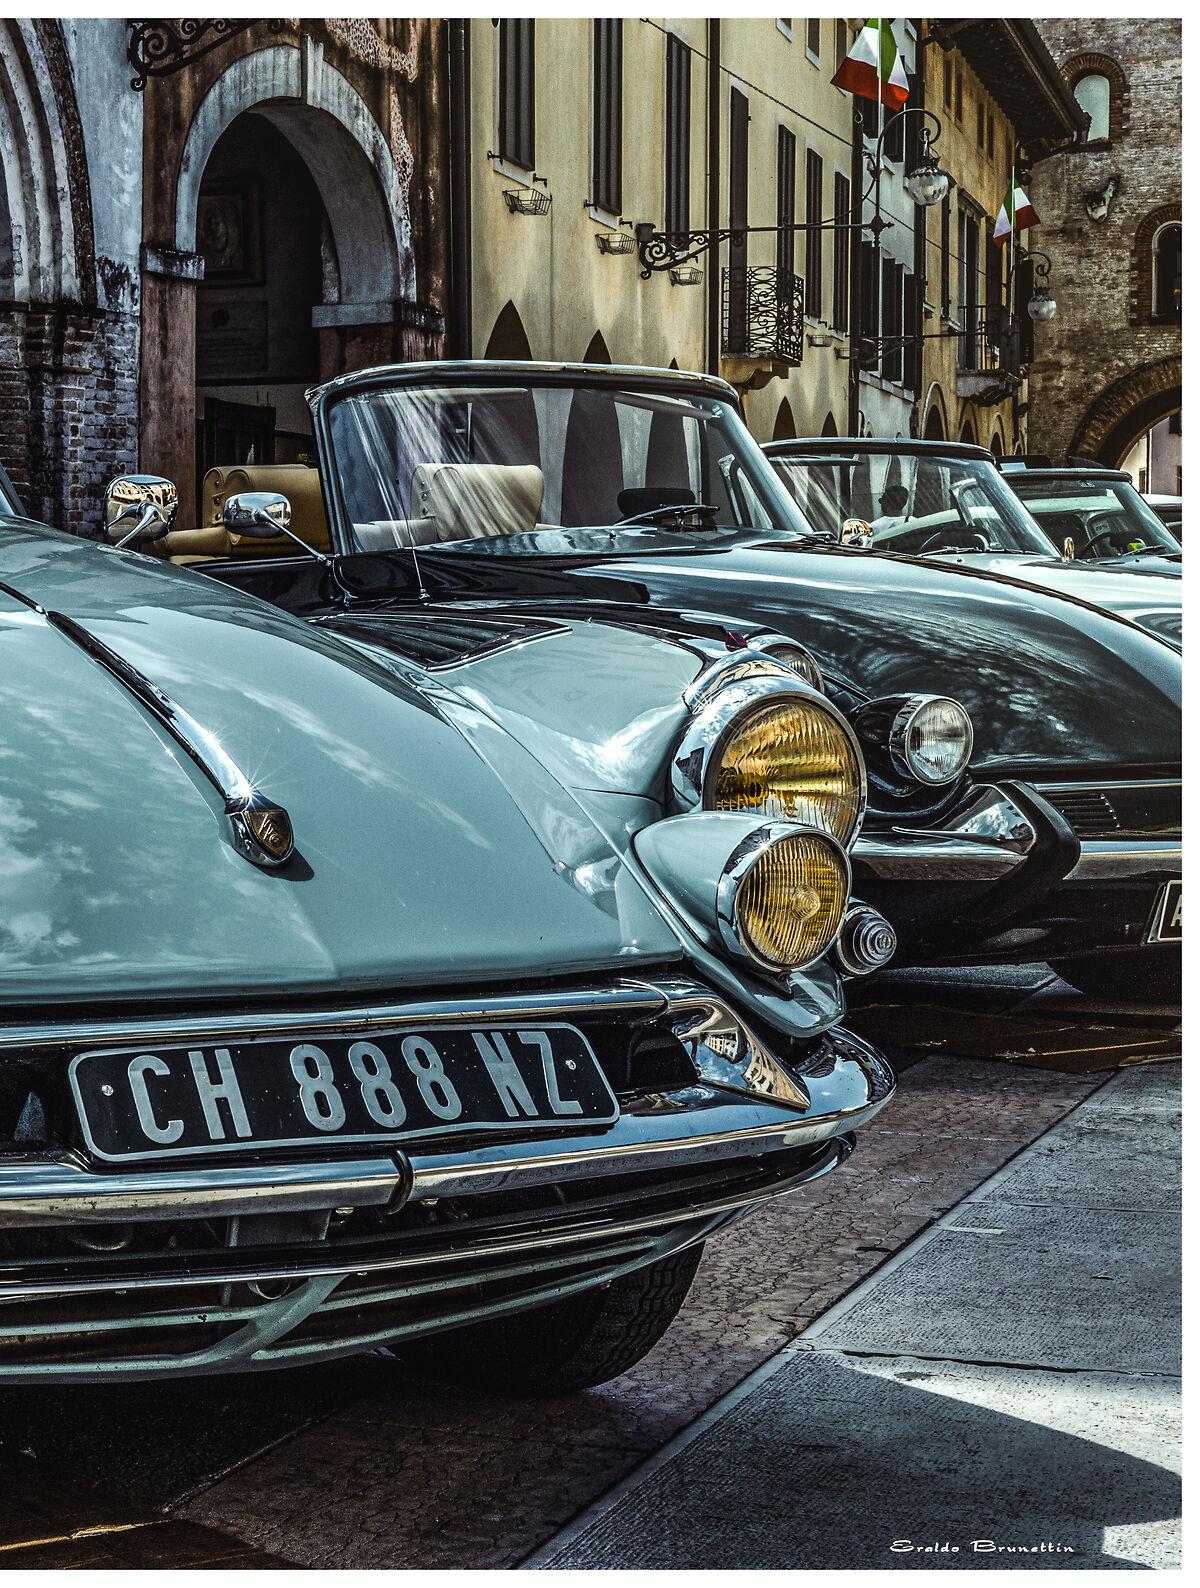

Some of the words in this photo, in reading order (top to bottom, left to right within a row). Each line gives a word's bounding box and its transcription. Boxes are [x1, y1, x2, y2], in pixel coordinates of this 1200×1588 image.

[126, 1048, 253, 1145] CH
[289, 1035, 463, 1132] 888
[472, 1031, 584, 1118] NZ
